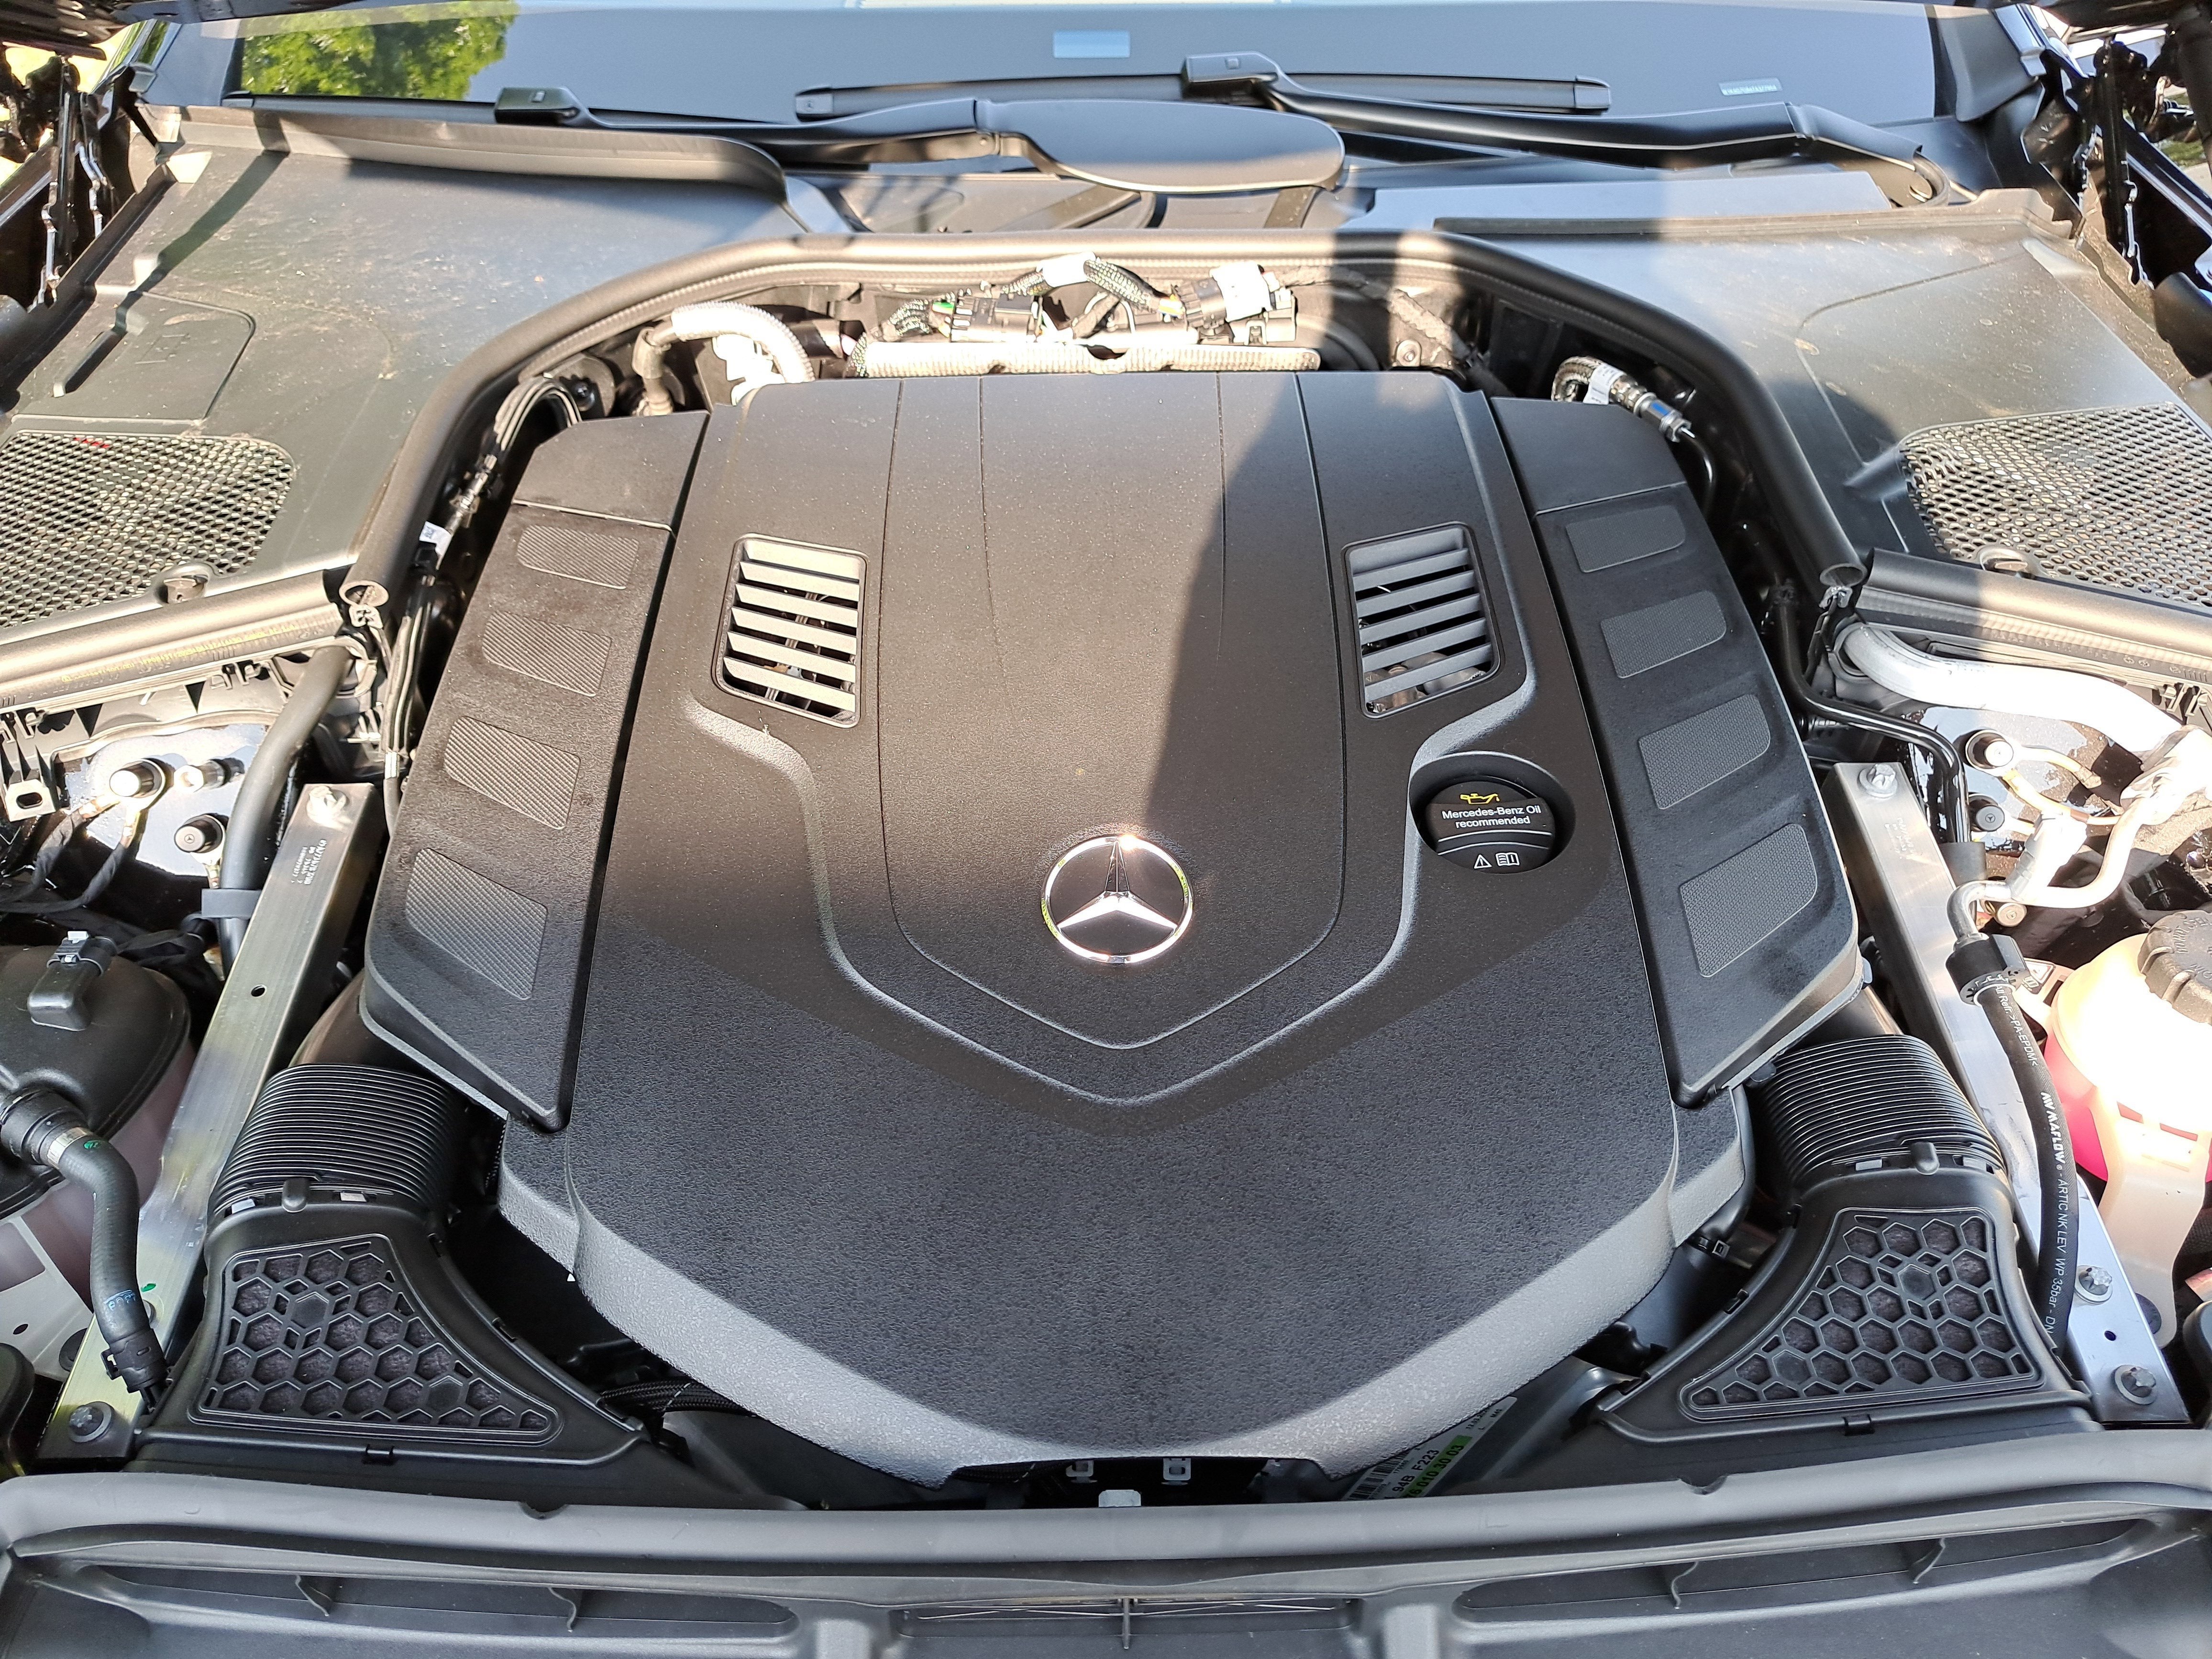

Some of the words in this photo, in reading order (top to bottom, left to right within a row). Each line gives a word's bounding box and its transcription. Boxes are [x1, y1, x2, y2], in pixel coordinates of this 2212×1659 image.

[1442, 806, 1525, 819] Mercedes-Benz
[1526, 805, 1541, 814] Oil
[1455, 816, 1530, 829] recommended
[2046, 1110, 2066, 1164] MAFLOW
[2057, 1178, 2069, 1211] ARTIC
[2057, 1213, 2068, 1229] NK
[2057, 1230, 2068, 1253] LEV
[2055, 1258, 2066, 1276] WP
[2049, 1278, 2063, 1308] 35bar
[2044, 1316, 2056, 1334] DN
[1392, 1475, 1416, 1492] 94B
[1411, 1449, 1439, 1471] F223
[1417, 1471, 1439, 1487] 010
[1433, 1459, 1452, 1470] 30
[1446, 1445, 1464, 1457] 03
